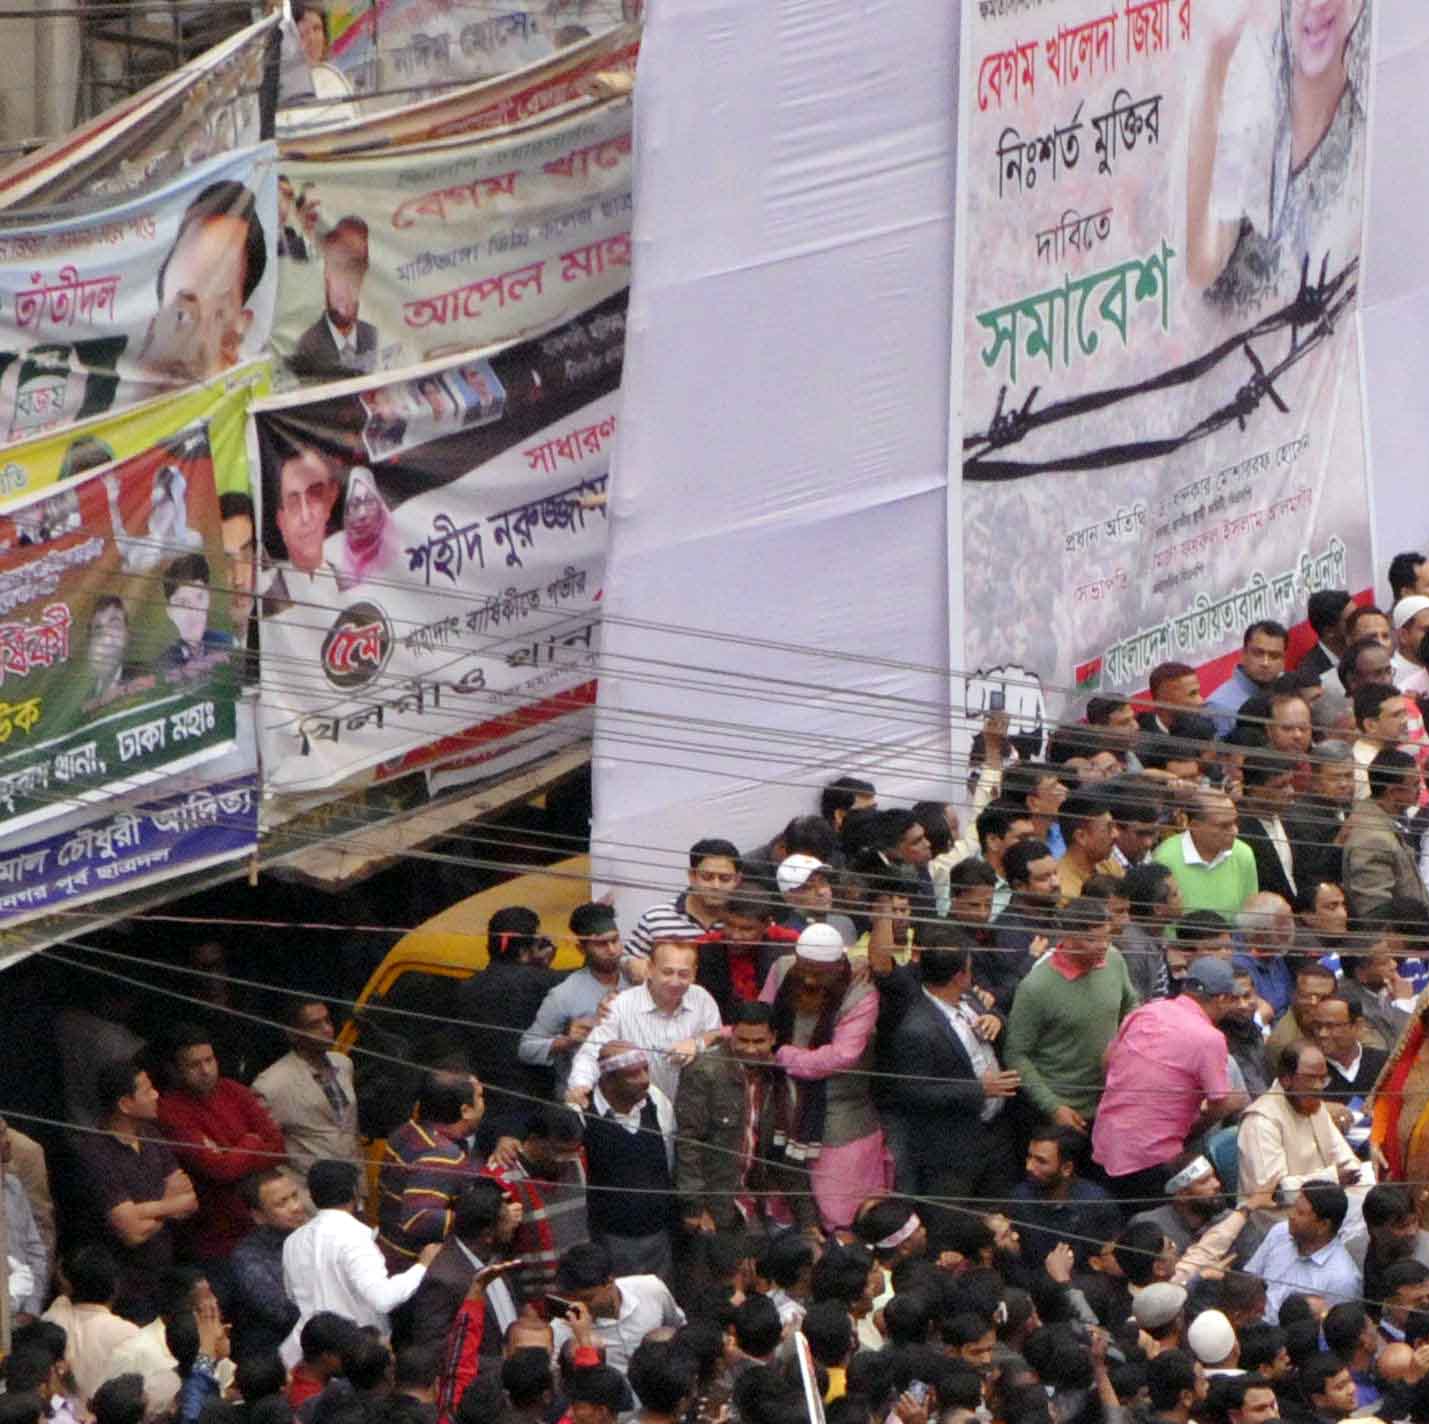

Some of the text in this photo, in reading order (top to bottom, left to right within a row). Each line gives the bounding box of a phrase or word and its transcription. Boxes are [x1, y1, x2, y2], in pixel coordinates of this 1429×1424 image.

[979, 42, 1038, 112] বেগম
[1046, 13, 1118, 85] খালেদা
[996, 89, 1163, 197] নিঃশর্ত মুক্তির
[392, 170, 526, 230] বেগম
[1036, 207, 1113, 262] দাবিতে
[15, 265, 124, 330] তাঁতীদল
[402, 261, 546, 328] আপেল
[976, 238, 1176, 385] সমাবেশ
[404, 514, 485, 586] শহীদ
[506, 619, 602, 669] থান
[1107, 626, 1170, 686] বাংলাদেশ
[1174, 572, 1271, 650] জাতীয়তাবাদী
[116, 718, 165, 762] ঢাকা
[58, 809, 144, 866] চৌধুরী
[96, 847, 171, 881] ছাত্রদল
